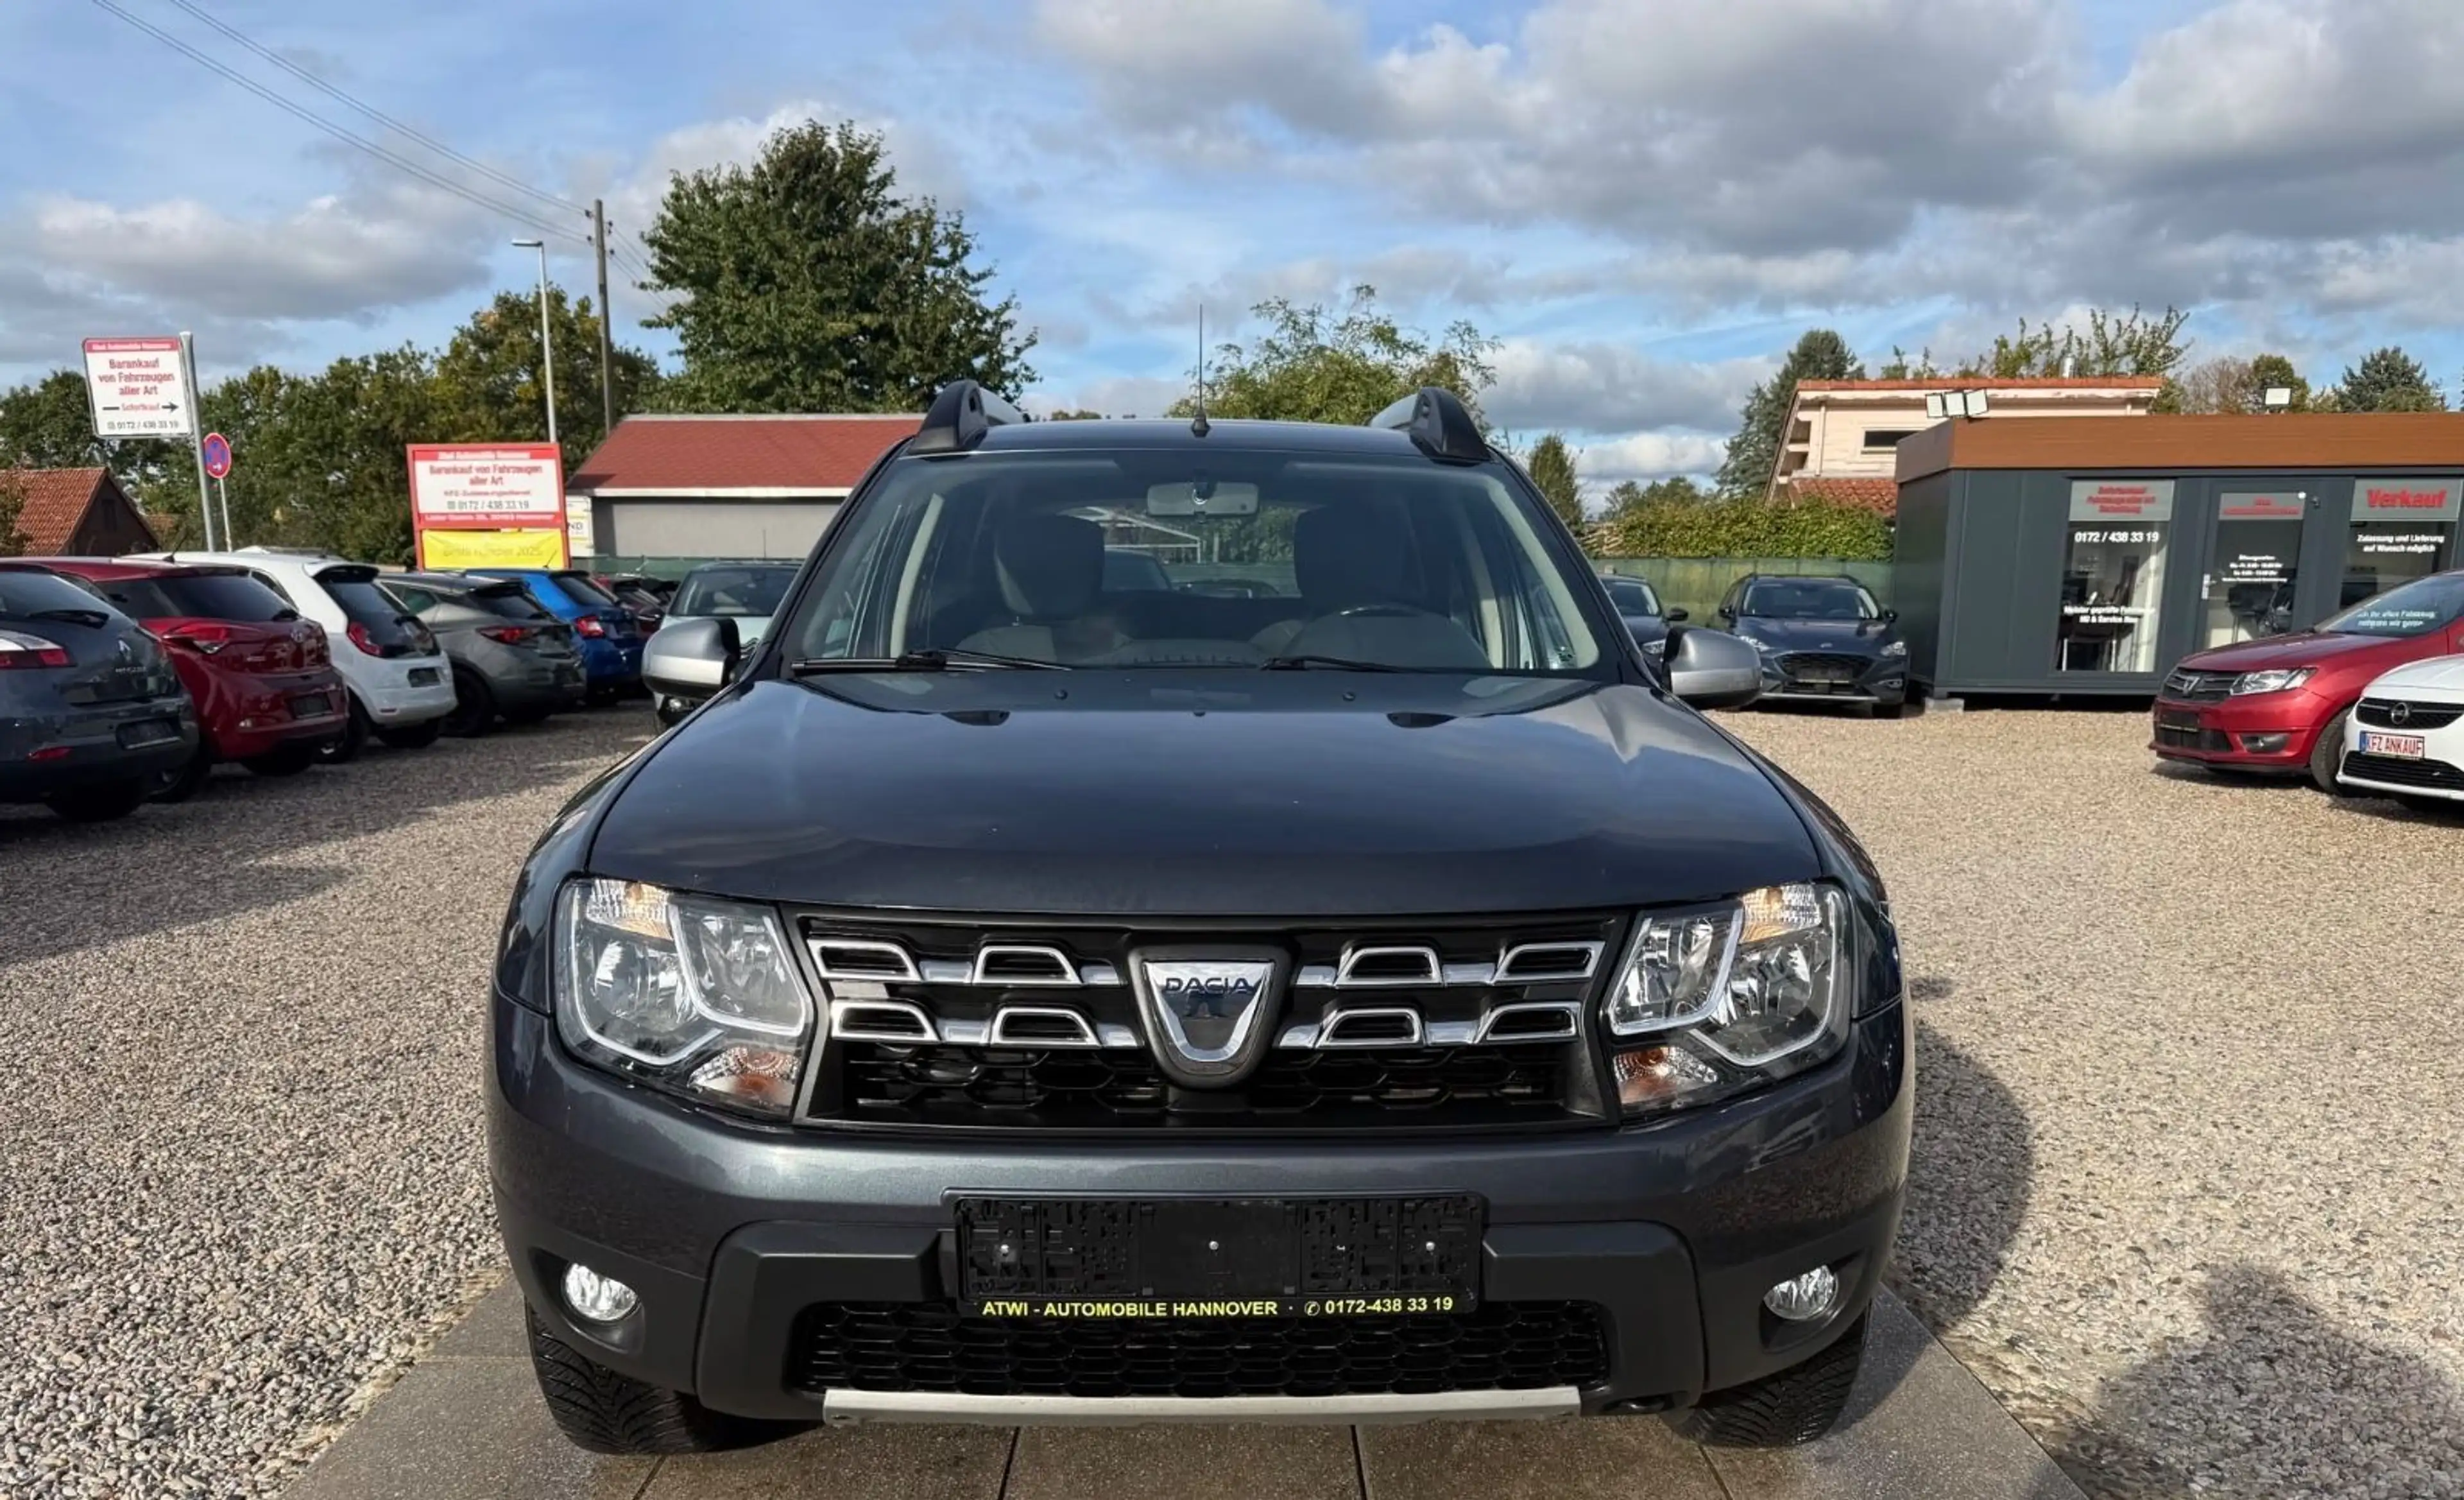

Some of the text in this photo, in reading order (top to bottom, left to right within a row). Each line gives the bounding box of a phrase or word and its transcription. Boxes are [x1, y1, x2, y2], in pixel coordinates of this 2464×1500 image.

[109, 358, 160, 369] Barankauf
[98, 372, 175, 384] von Fahrzeugen
[119, 386, 158, 395] aller Art
[429, 463, 543, 475] Barankauf von Fahrzeugen
[469, 476, 504, 486] aller Art
[2366, 489, 2447, 508] Verkauf
[2074, 531, 2100, 542] 0172
[2109, 531, 2128, 542] 438
[2130, 531, 2144, 542] 33
[2146, 531, 2160, 542] 19
[2384, 737, 2422, 755] ANKAUF
[1164, 977, 1253, 992] DACIA
[982, 1301, 1028, 1316] ATWI
[1043, 1302, 1167, 1316] AUTOMOBILE
[1173, 1301, 1278, 1316] HANNOVER
[1324, 1298, 1402, 1315] 0172-438
[1407, 1297, 1428, 1312] 33
[1433, 1296, 1453, 1311] 19
